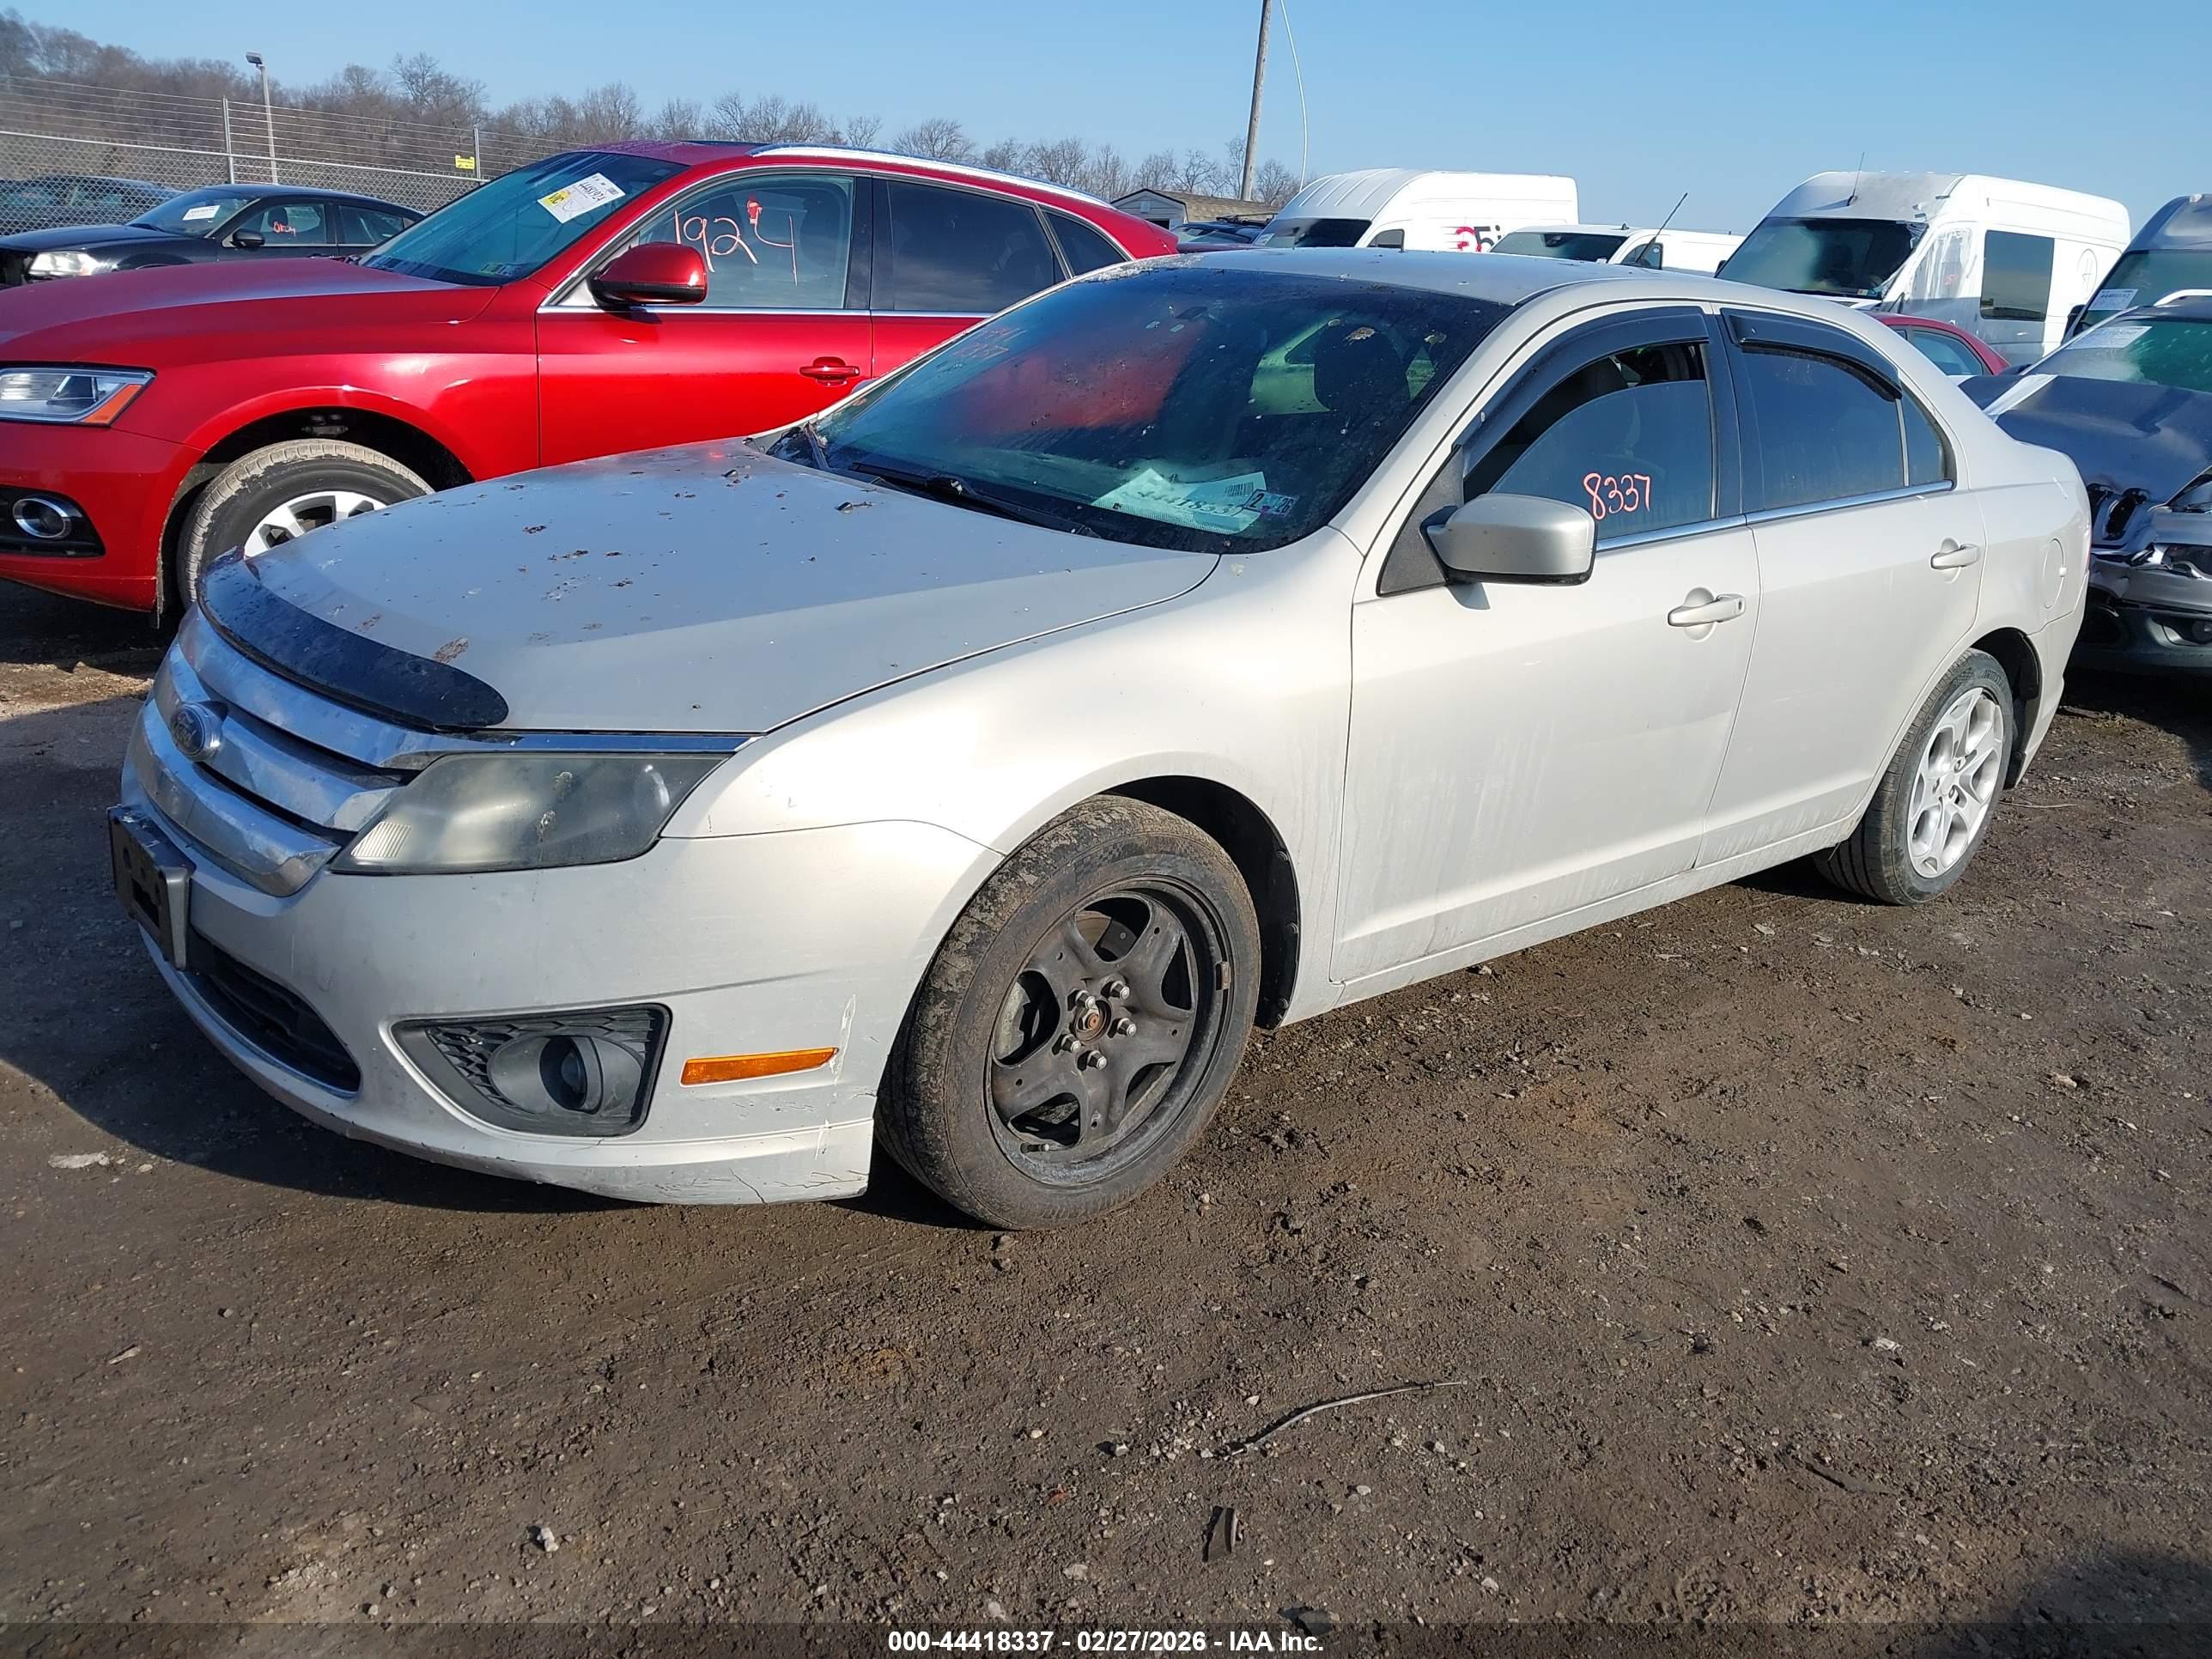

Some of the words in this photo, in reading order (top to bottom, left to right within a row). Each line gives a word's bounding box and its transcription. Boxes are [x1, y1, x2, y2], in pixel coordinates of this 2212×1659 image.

[673, 199, 798, 287] 1924
[1250, 492, 1265, 508] 2
[1583, 472, 1651, 520] 8337
